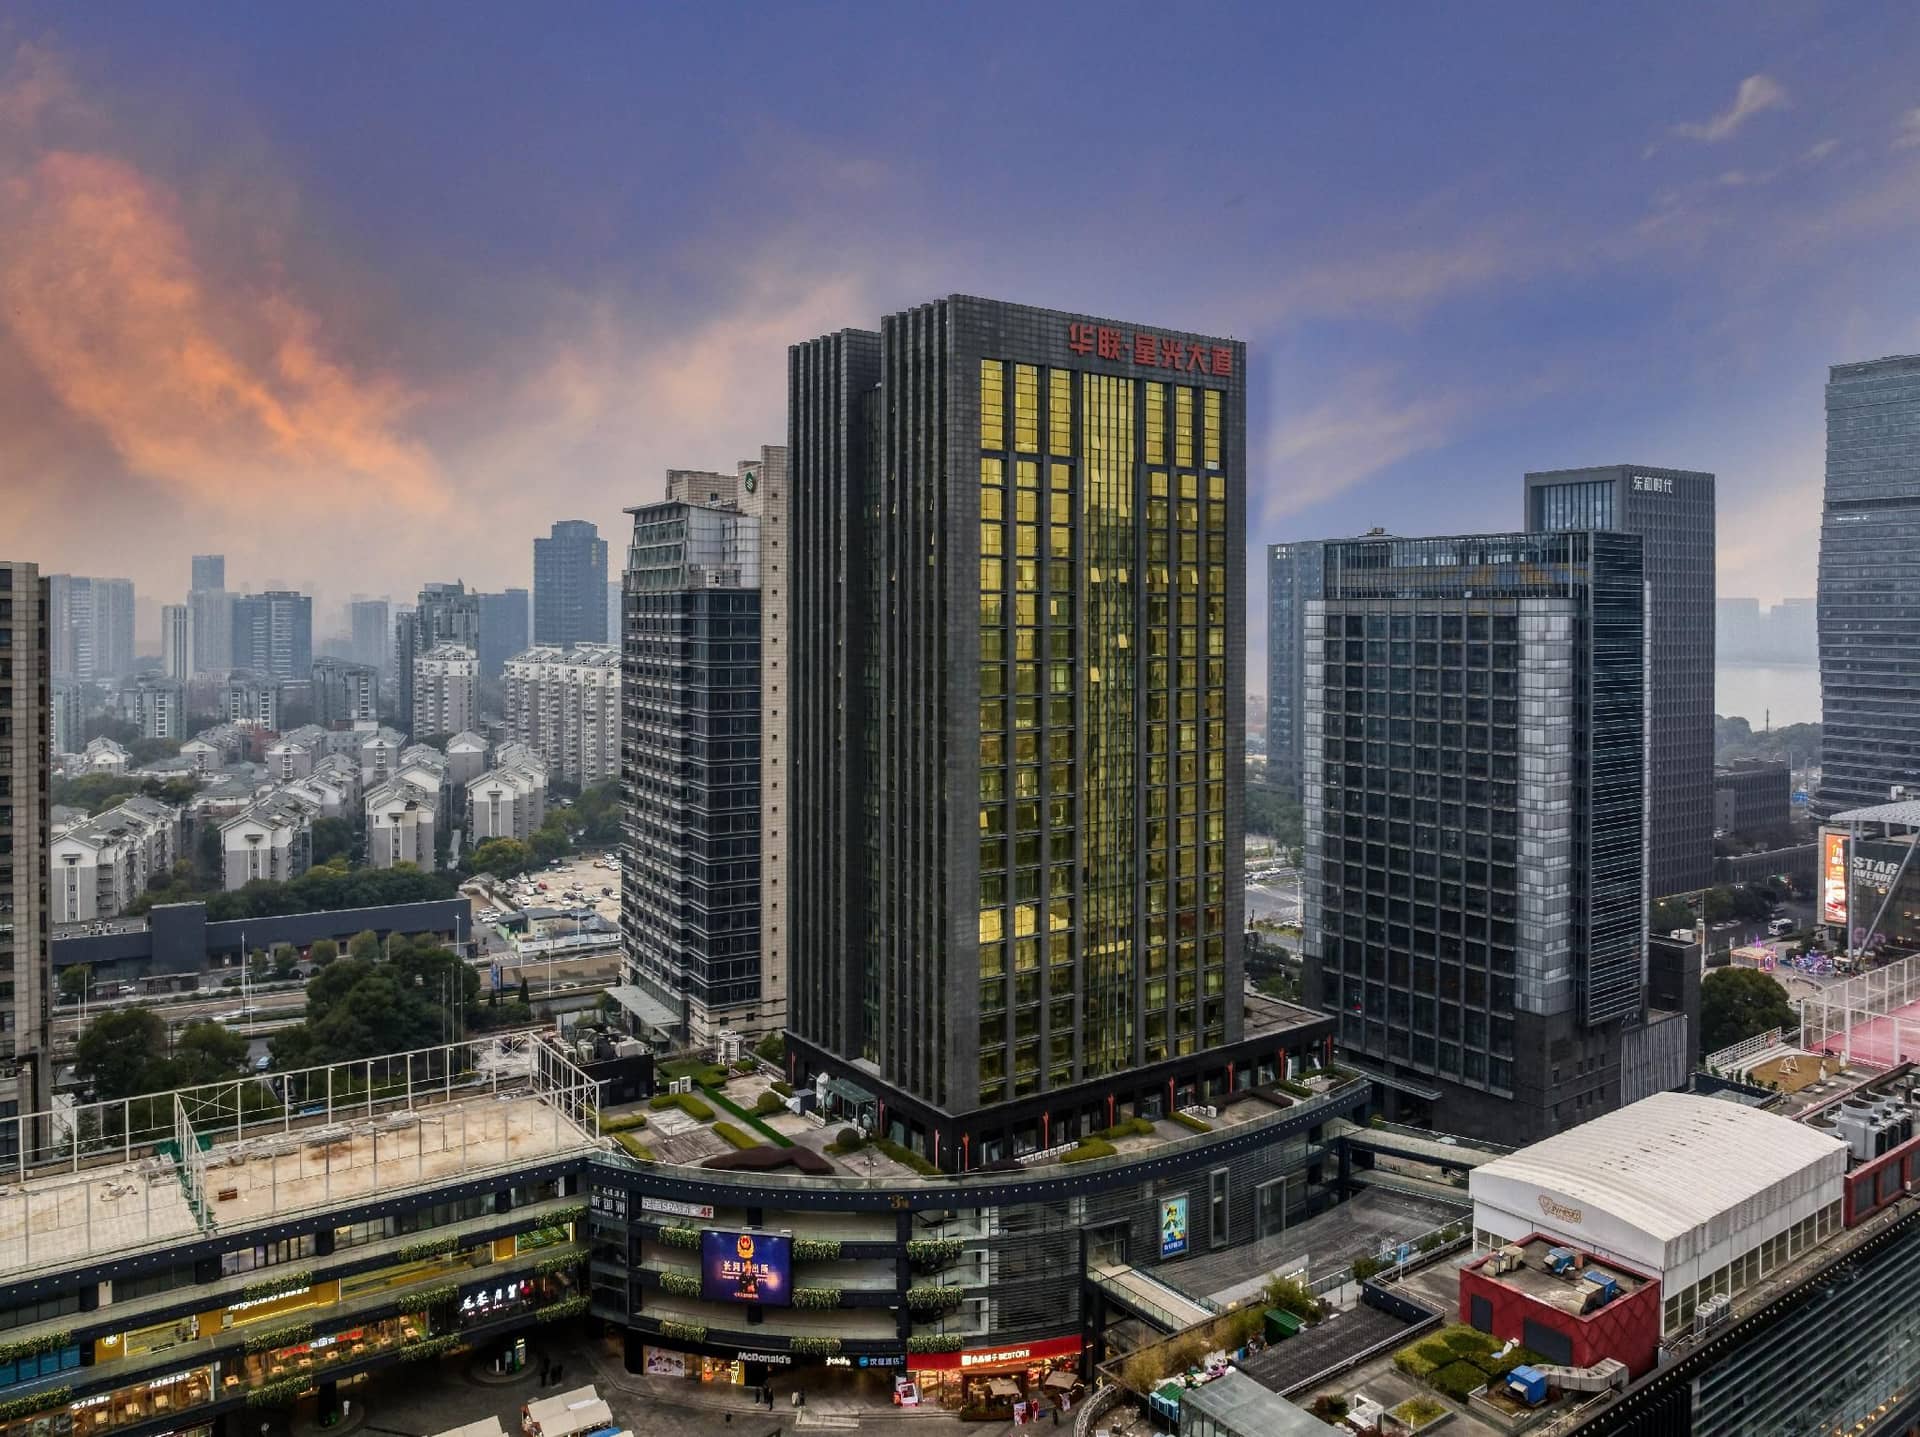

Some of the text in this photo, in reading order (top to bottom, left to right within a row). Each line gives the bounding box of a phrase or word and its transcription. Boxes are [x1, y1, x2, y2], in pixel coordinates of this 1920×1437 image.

[1853, 856, 1900, 875] STAR
[700, 1207, 713, 1217] 4F
[737, 1351, 792, 1365] McDonald's
